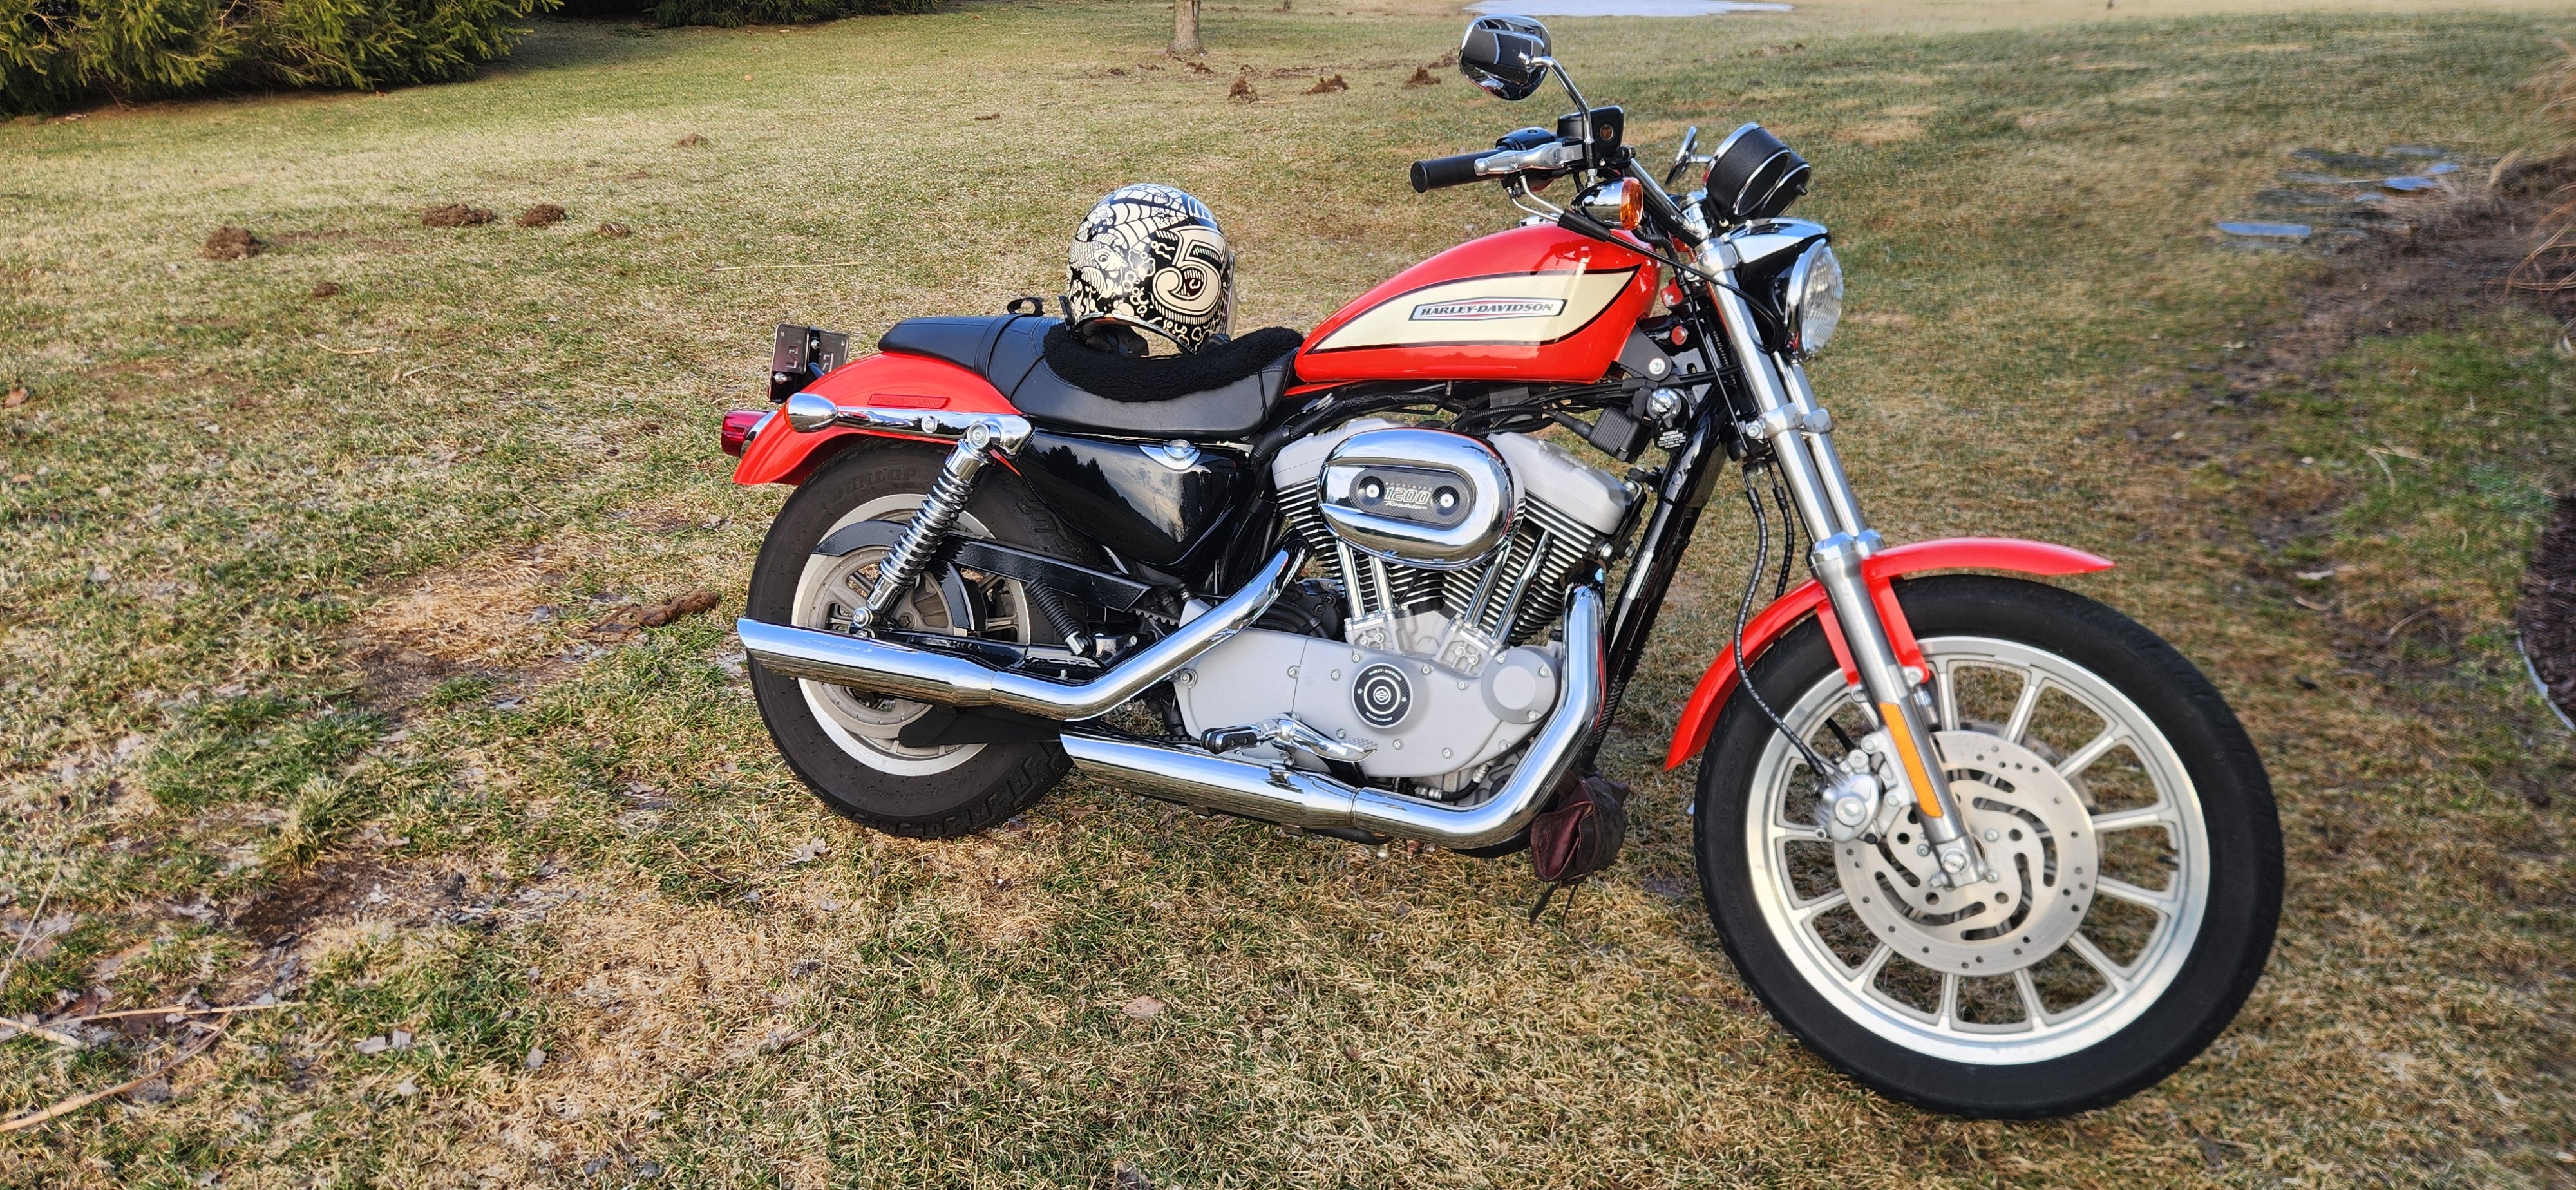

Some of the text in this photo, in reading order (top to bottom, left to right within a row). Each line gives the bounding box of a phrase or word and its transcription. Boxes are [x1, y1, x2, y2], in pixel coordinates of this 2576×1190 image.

[1153, 225, 1226, 316] 5
[1420, 303, 1554, 316] HARLEY-DAVIDSON
[833, 468, 918, 504] DUNLOP
[1384, 486, 1430, 505] 1200
